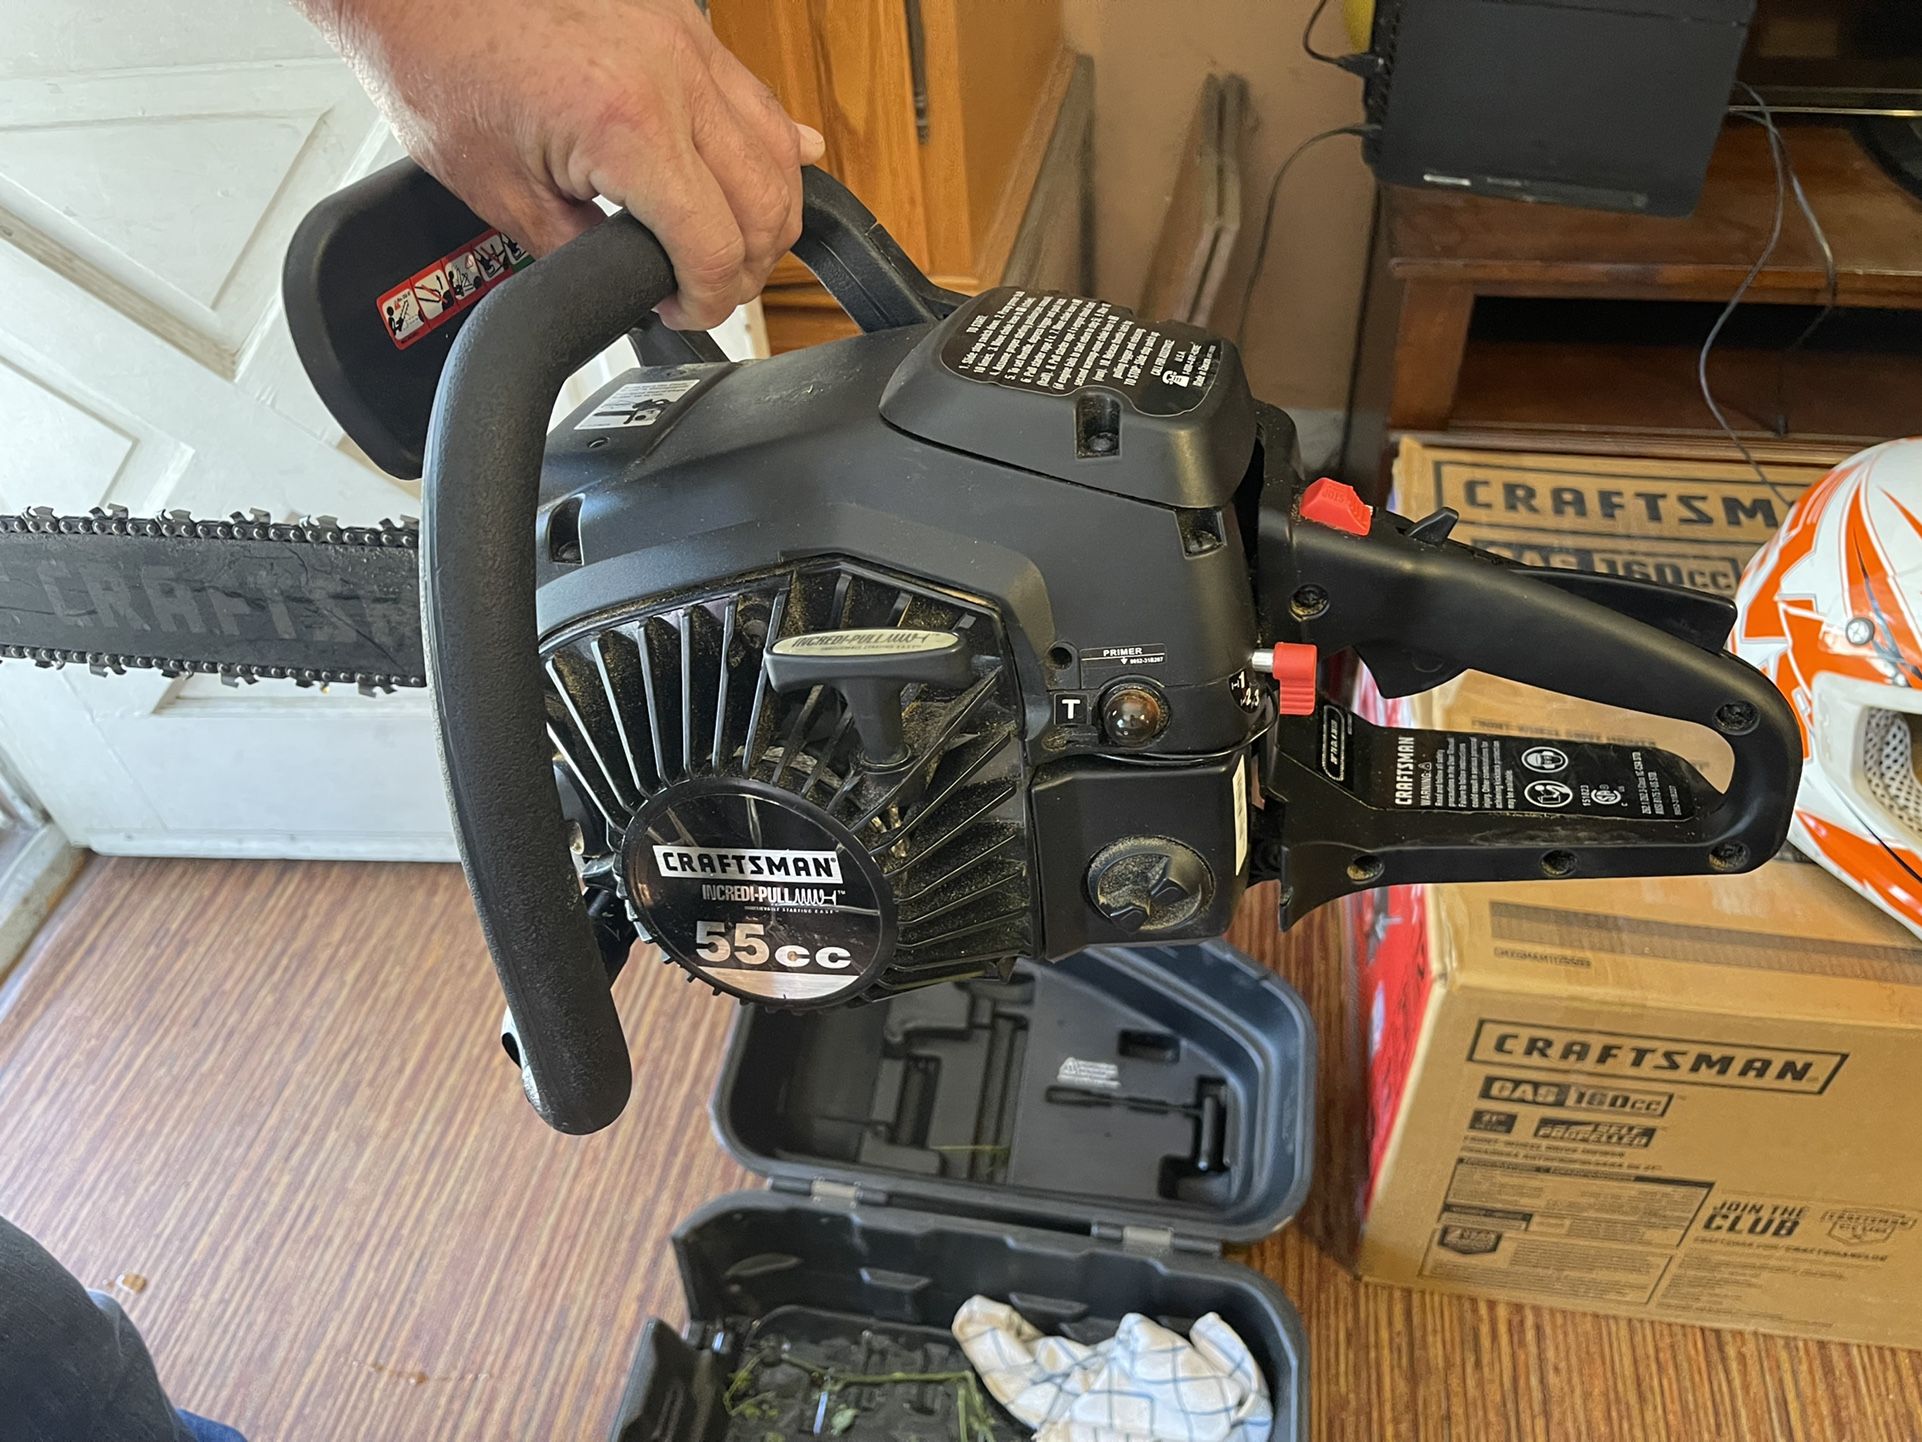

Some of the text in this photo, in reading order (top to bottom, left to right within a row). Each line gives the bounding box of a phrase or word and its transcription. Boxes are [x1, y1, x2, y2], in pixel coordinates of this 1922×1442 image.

[1464, 479, 1779, 528] CRAFTSM
[1103, 647, 1143, 657] PRIMER
[1061, 698, 1081, 719] T
[1396, 737, 1414, 804] CRAFTSMAN
[663, 851, 834, 878] CRAFTSMAN
[702, 884, 796, 904] INCREDI-PULL
[696, 920, 851, 970] 55cc
[1493, 1033, 1815, 1083] CRAFTSMAN
[1489, 1079, 1560, 1103] GAS
[1712, 1200, 1811, 1219] JOIN THE
[1702, 1213, 1801, 1238] CLUB
